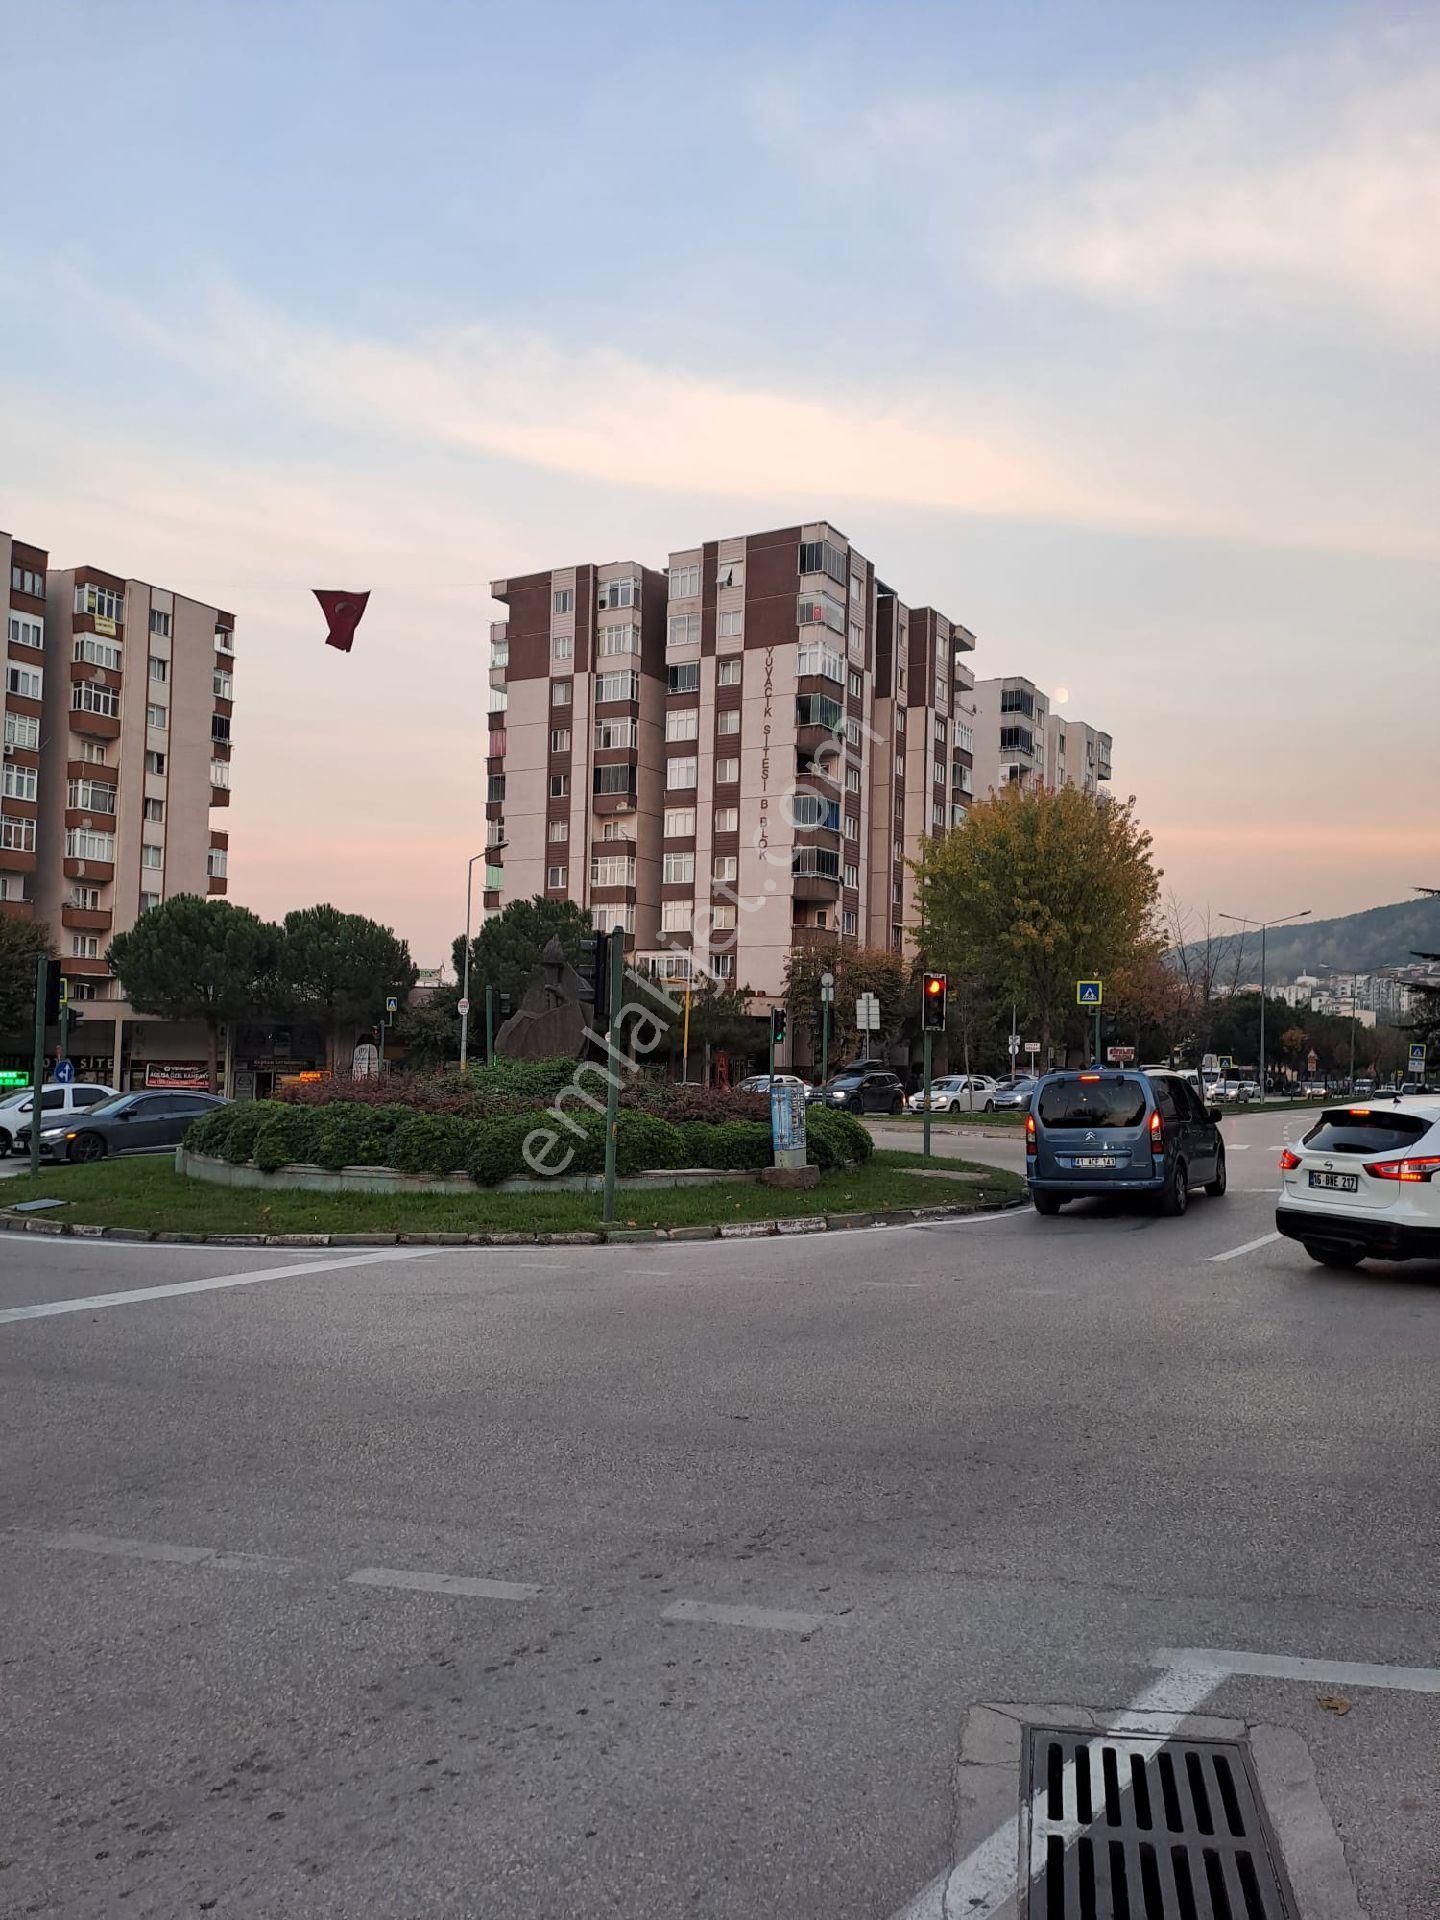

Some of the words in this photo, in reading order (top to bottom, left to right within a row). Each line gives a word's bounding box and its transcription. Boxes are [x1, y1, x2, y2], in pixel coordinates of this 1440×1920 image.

[764, 646, 774, 718] YUVACIK
[760, 799, 768, 810] B
[759, 817, 769, 861] BLOK
